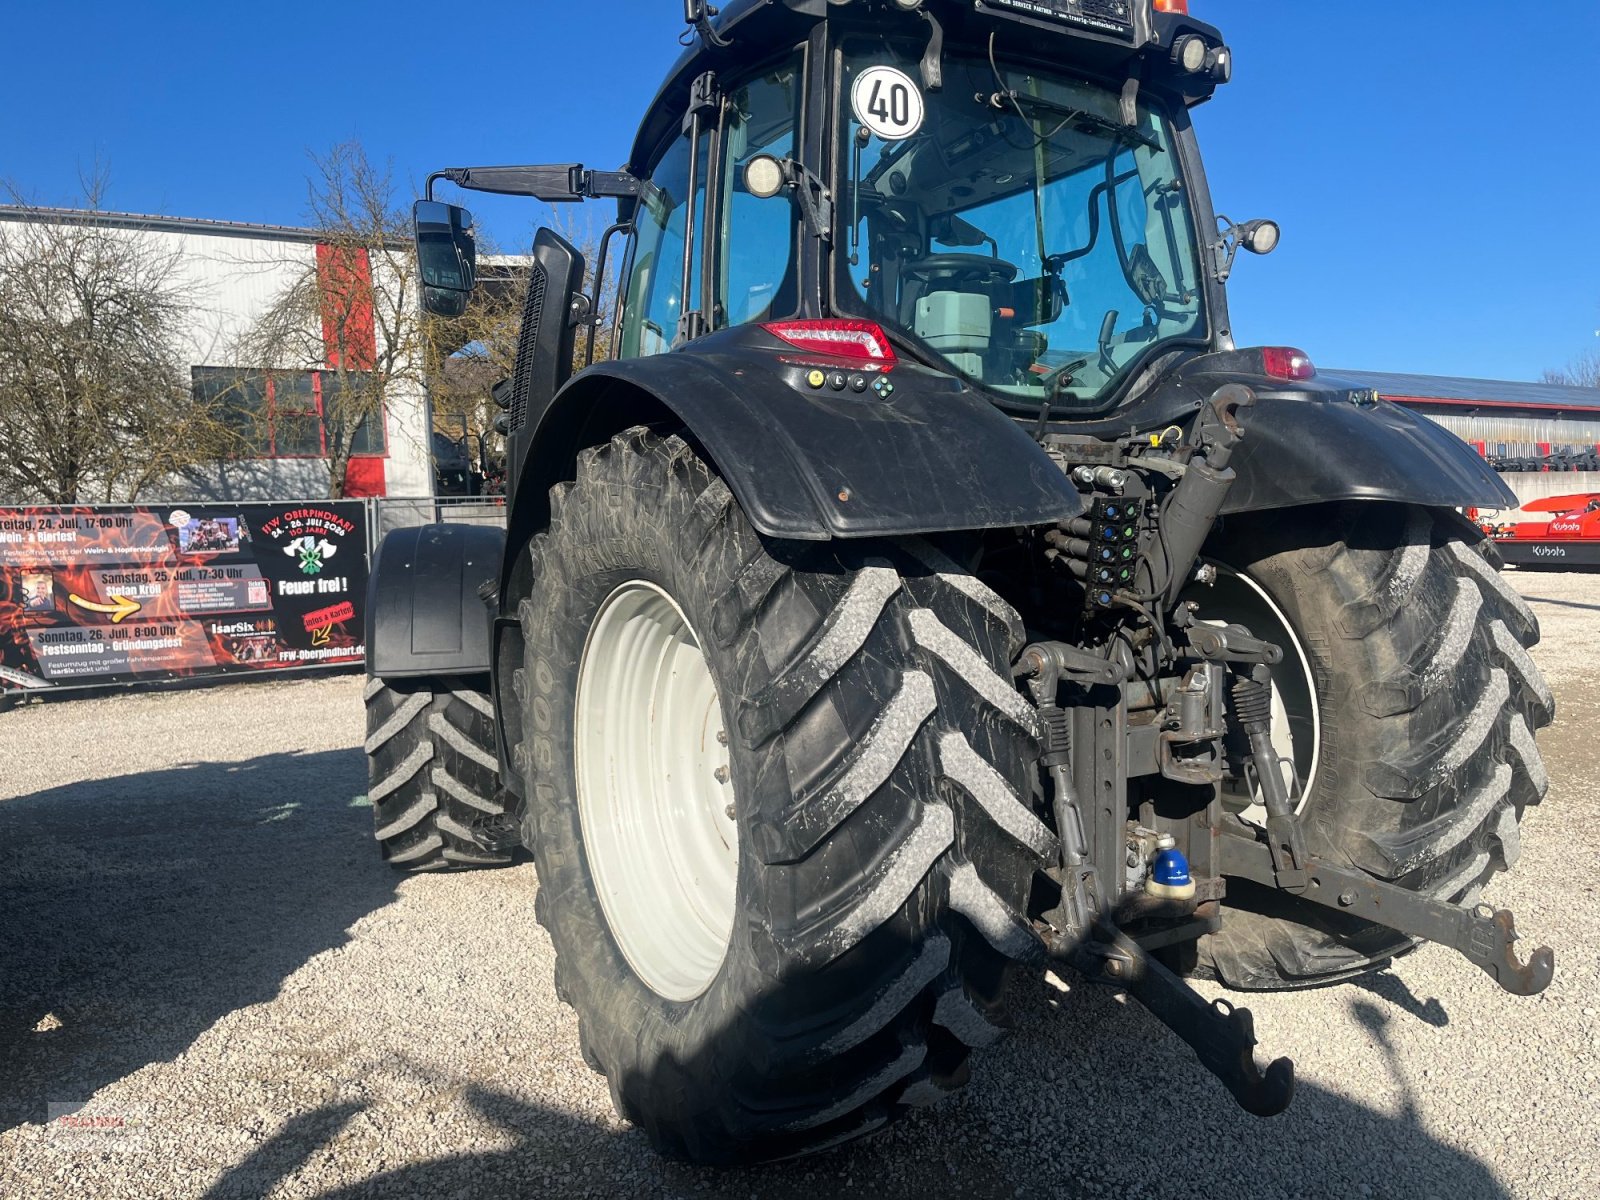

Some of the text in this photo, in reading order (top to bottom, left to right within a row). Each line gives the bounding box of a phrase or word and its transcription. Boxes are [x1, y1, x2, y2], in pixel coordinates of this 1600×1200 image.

[1012, 1, 1032, 10] SERVICE
[1033, 5, 1052, 15] PARTNER
[867, 79, 909, 127] 40
[0, 517, 134, 531] reitag, 24. Juli, 17:00 Uhr
[284, 508, 355, 533] OBERPINDHART
[306, 518, 322, 527] JULI
[323, 520, 346, 537] 2026
[1552, 521, 1580, 531] Kubota
[1532, 545, 1566, 557] Kubota
[101, 567, 243, 585] Samstag, 25. Juli, 17:30 Uhr
[105, 583, 161, 597] Stefan Kröll
[278, 580, 316, 596] Feuer
[317, 576, 341, 593] frei
[38, 625, 177, 644] Sonntag, 26. Juli, 8:00 Uhr
[211, 621, 255, 635] IsarSix
[42, 641, 105, 657] Festsonntag
[112, 637, 183, 652] Gründungsfest
[279, 644, 365, 662] FFW-Oberpindhart.de
